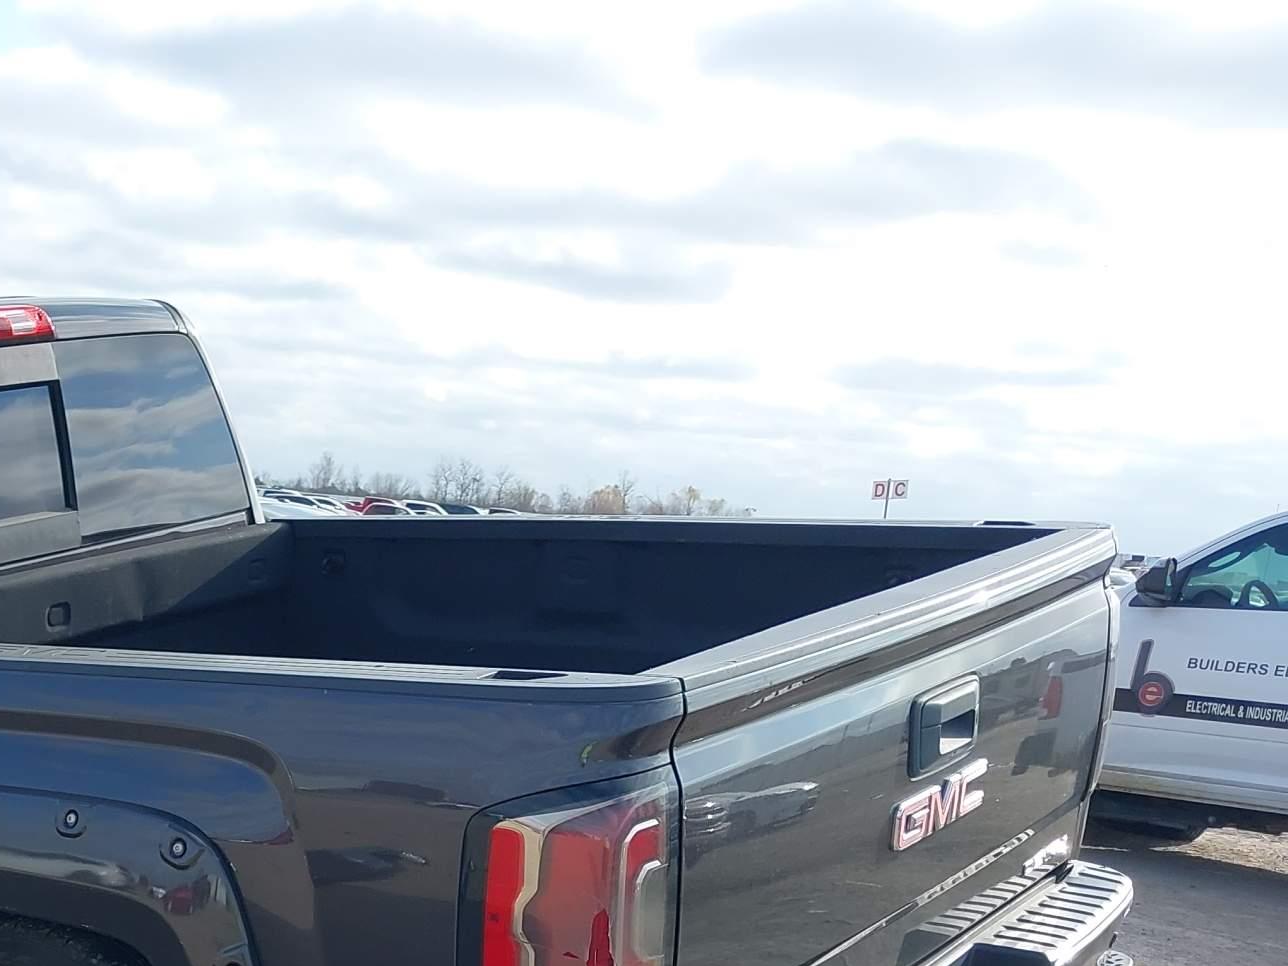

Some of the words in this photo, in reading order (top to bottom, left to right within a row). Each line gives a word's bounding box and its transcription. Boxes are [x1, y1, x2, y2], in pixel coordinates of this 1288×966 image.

[874, 483, 885, 497] D
[895, 482, 906, 496] C
[1187, 657, 1269, 675] BUILDERS
[1274, 665, 1288, 677] E
[1186, 700, 1236, 716] ELECTRICAL
[1237, 706, 1244, 718] &
[891, 758, 988, 850] GMC
